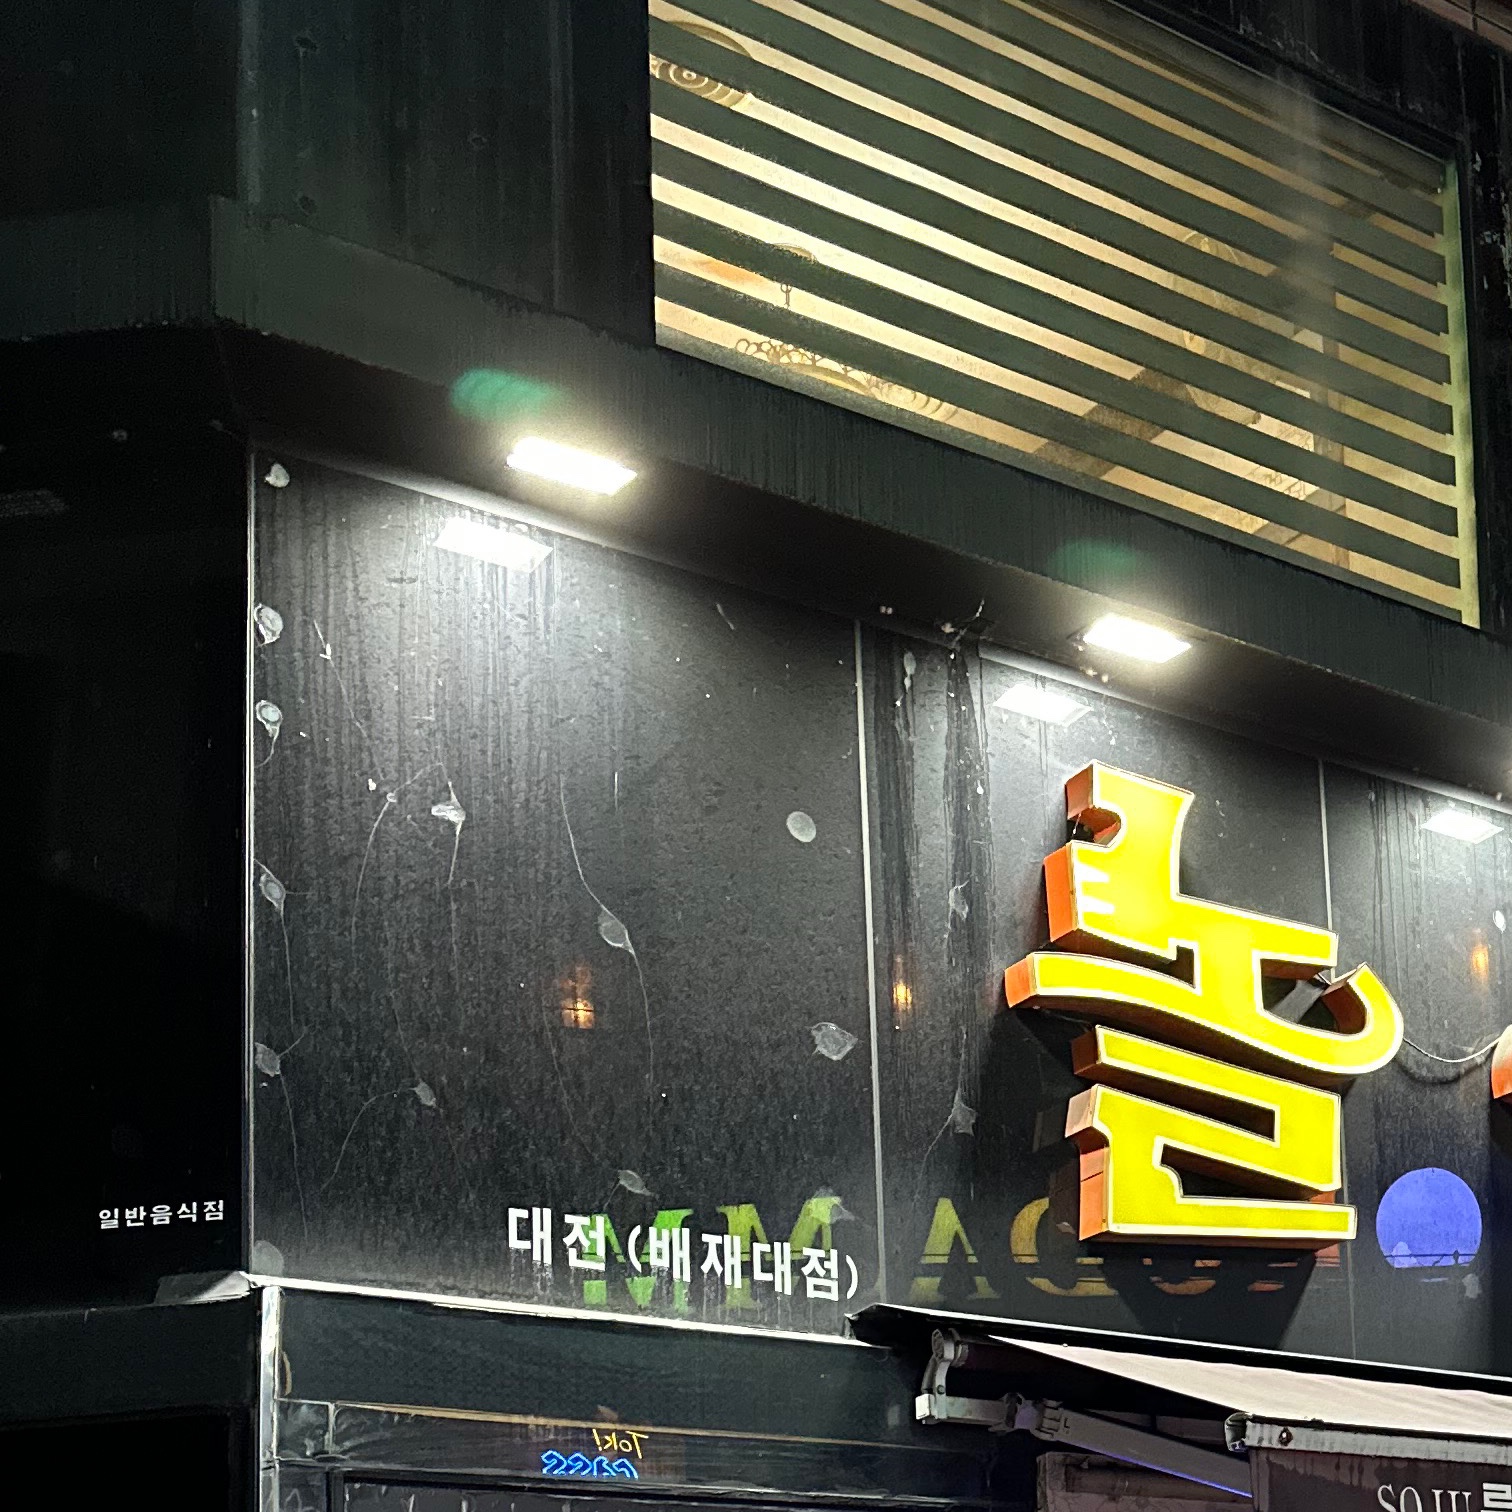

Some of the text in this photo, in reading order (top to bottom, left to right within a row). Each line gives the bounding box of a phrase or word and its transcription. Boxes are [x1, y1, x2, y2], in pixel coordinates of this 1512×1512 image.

[98, 1199, 226, 1230] 일반음식점
[507, 1205, 607, 1272] 대전
[628, 1224, 861, 1302] (배재대점)
